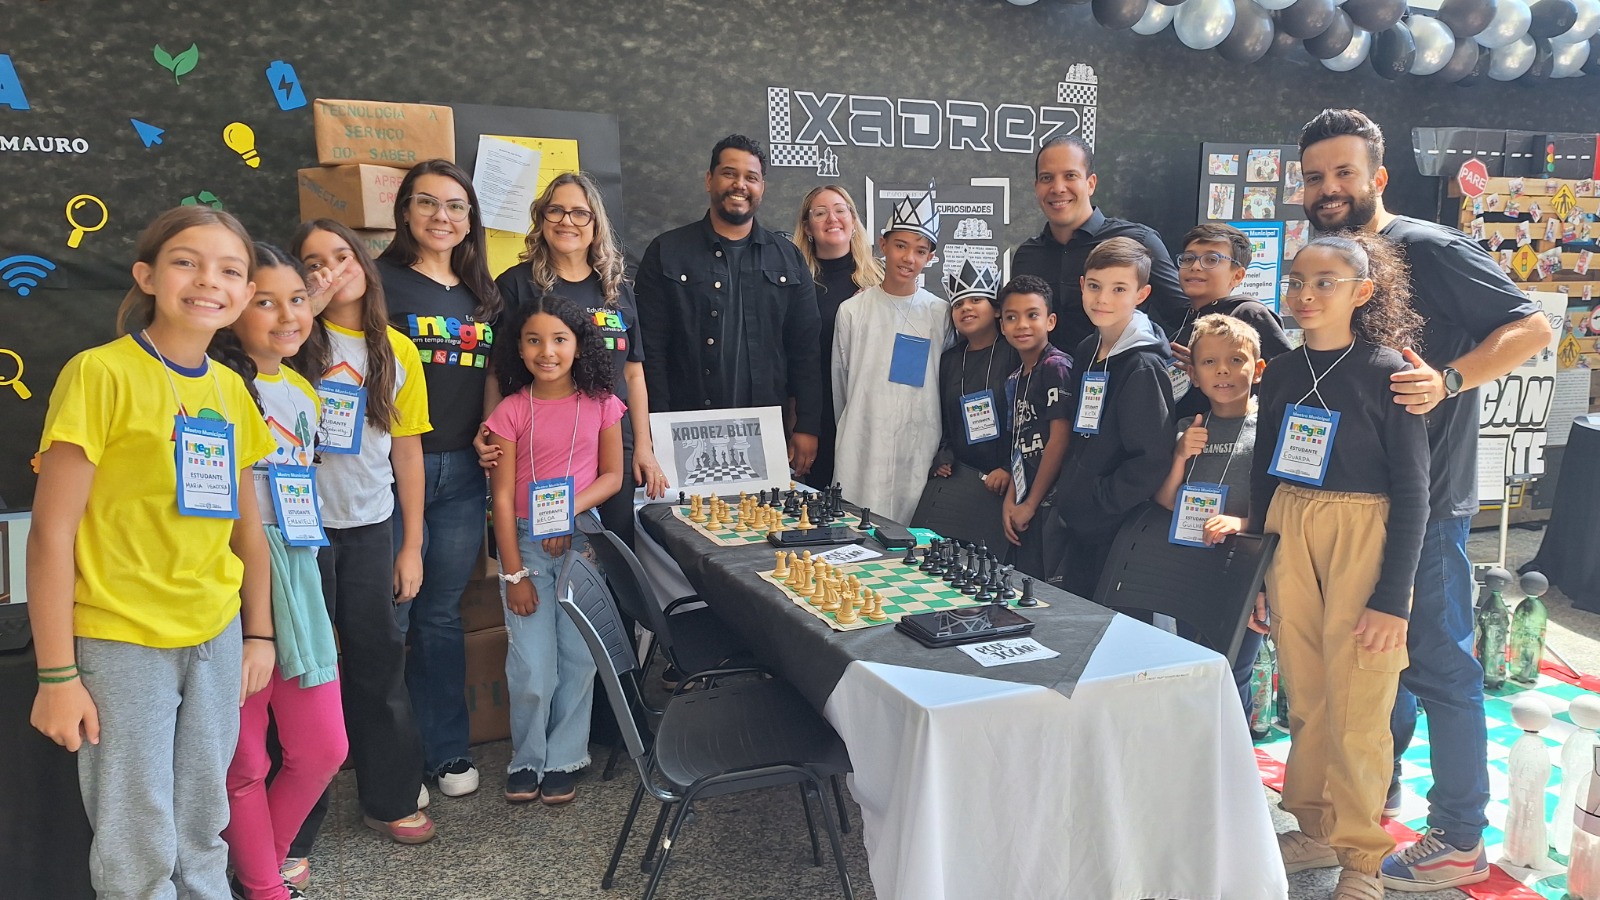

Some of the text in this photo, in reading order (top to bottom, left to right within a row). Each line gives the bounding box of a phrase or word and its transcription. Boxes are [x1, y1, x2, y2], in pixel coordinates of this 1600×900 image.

[320, 104, 406, 120] TECNOLOGIA
[0, 135, 89, 154] MAURO
[369, 148, 416, 162] SABER
[1460, 167, 1487, 190] PARE
[936, 205, 992, 214] CURIOSIDADES
[1250, 230, 1276, 238] Municipal
[672, 422, 762, 441] XADREZ BLITZ
[1289, 421, 1327, 437] Integral
[185, 440, 225, 458] Integral
[1289, 445, 1318, 455] ESTUDANTE
[190, 471, 223, 481] ESTUDANTE
[279, 483, 310, 497] Integral
[535, 489, 566, 502] Integral
[1185, 495, 1218, 507] Integral
